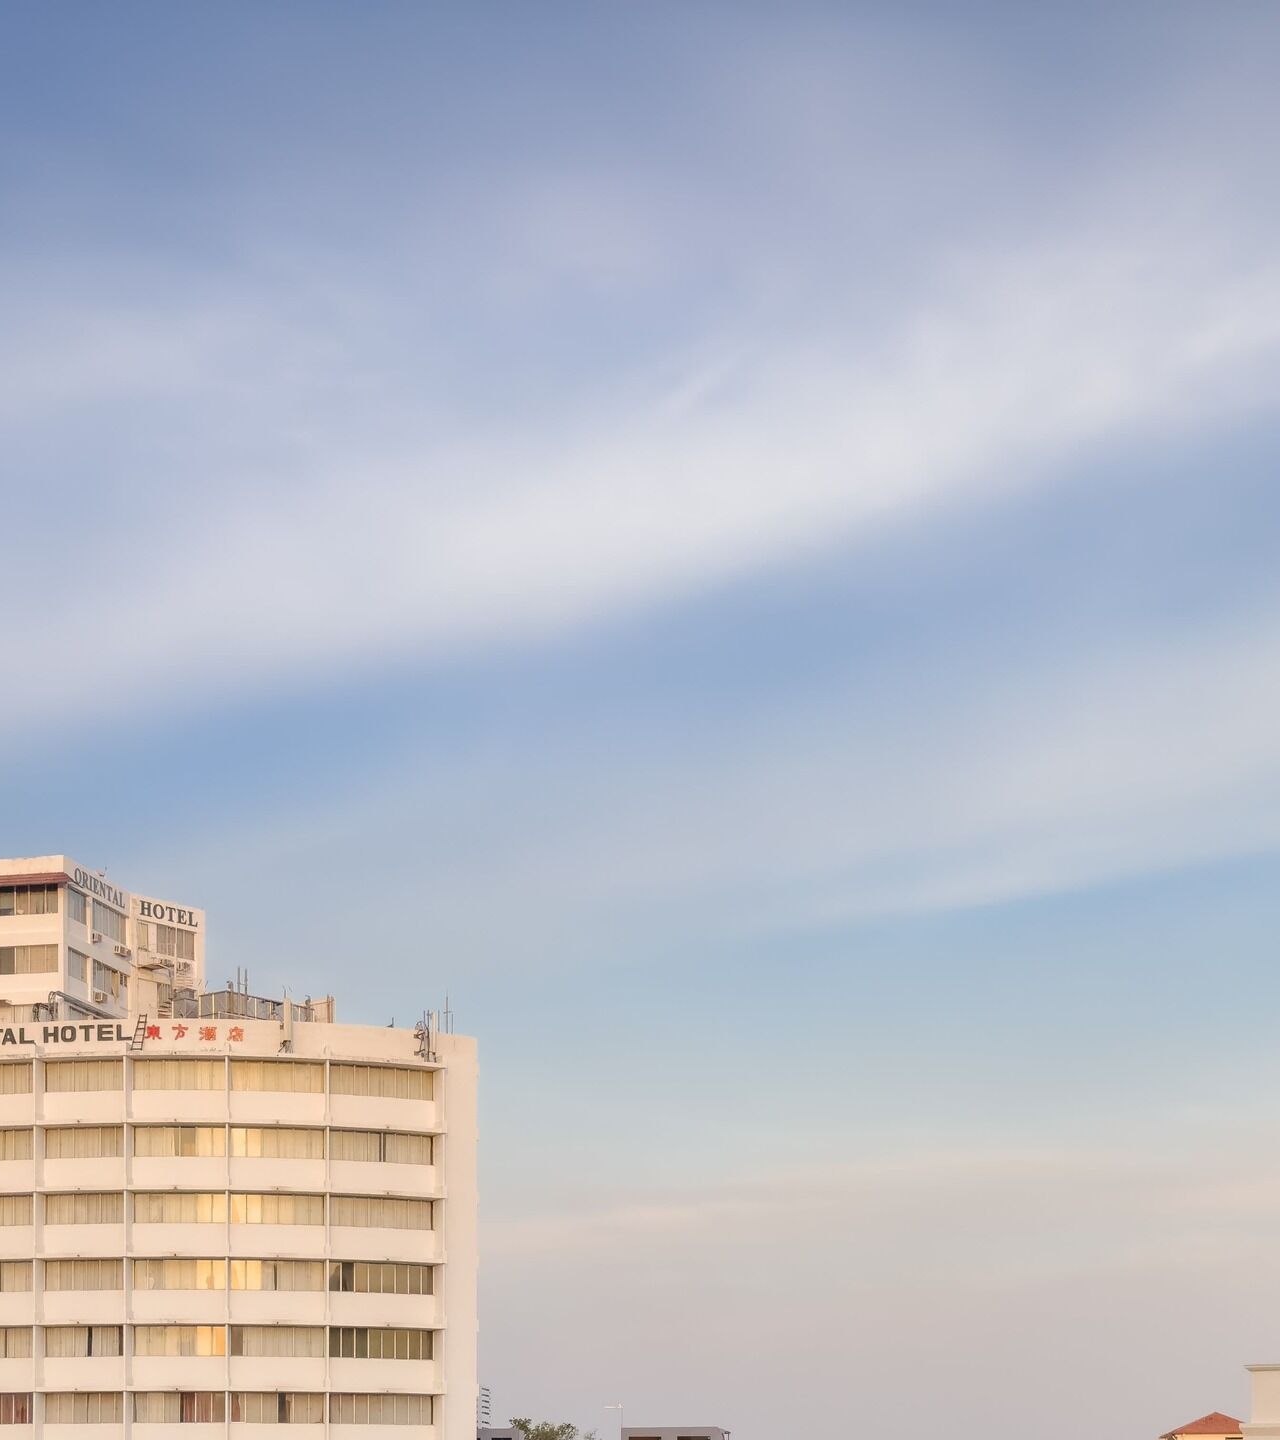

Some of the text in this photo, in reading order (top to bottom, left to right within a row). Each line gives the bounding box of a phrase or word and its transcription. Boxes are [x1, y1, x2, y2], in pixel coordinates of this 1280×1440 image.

[74, 867, 198, 927] ORIENTAL HOTEL
[43, 1024, 132, 1044] HOTEL
